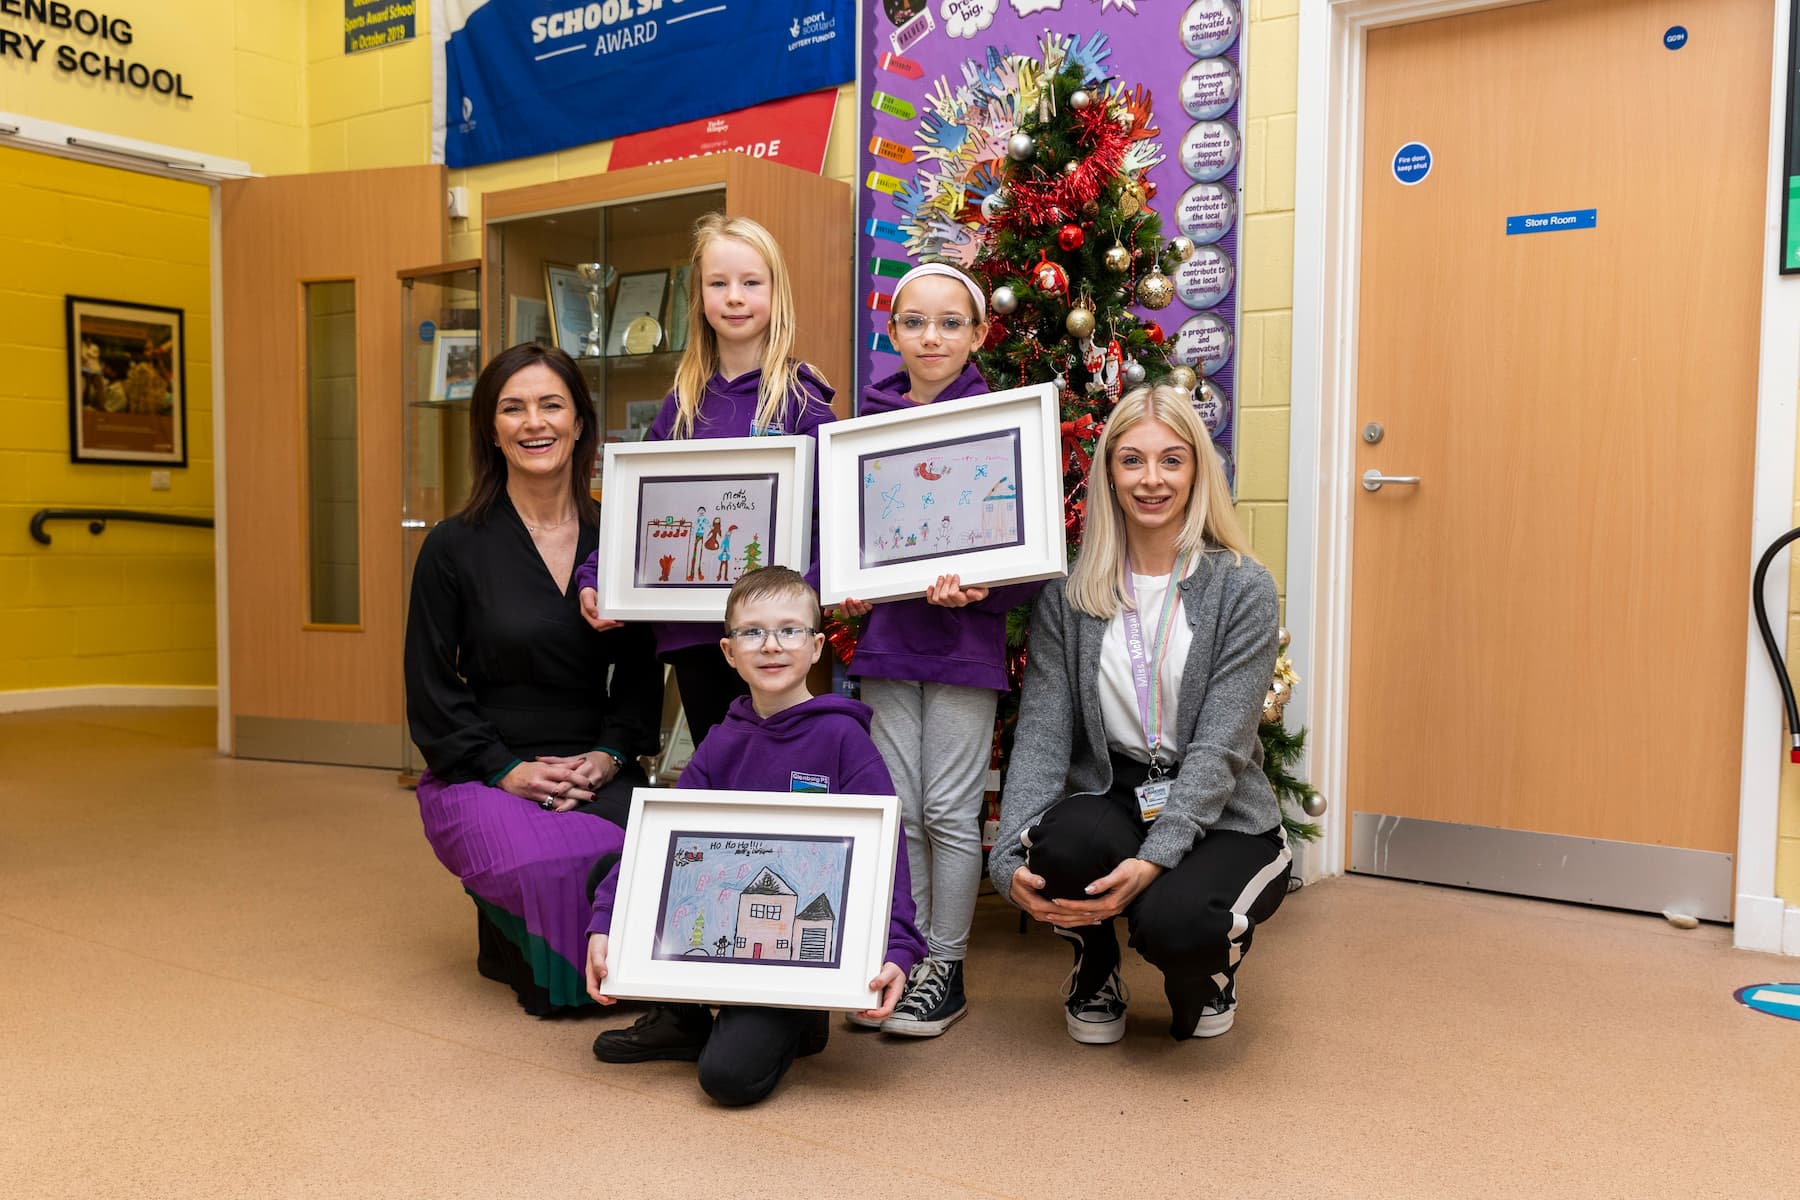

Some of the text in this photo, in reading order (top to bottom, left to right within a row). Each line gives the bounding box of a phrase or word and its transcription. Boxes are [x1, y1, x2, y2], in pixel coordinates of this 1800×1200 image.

[366, 10, 389, 26] Award
[389, 0, 416, 20] School
[948, 0, 974, 16] Dre
[0, 0, 133, 45] ENBOIG
[531, 0, 633, 43] SCHOOL
[803, 10, 825, 26] sport
[1189, 16, 1233, 32] motivated &
[802, 16, 836, 35] scotland
[351, 23, 406, 50] in October 2019
[594, 20, 658, 57] AWARD
[898, 20, 926, 46] VALUES
[1192, 28, 1230, 42] challenged
[788, 31, 837, 52] LOTTERY FUNDED
[57, 45, 193, 101] SCHOOL
[1192, 70, 1231, 84] improvement
[1199, 81, 1223, 92] through
[1194, 90, 1219, 101] support
[1189, 97, 1229, 109] collaboration
[1203, 131, 1220, 140] build
[1192, 139, 1231, 151] resilience to
[1198, 150, 1223, 161] support
[1398, 154, 1426, 164] Fire door
[1194, 158, 1225, 169] challenge
[1397, 162, 1428, 172] keep shut
[1192, 193, 1223, 203] value and
[1185, 202, 1229, 214] contribute to
[1192, 210, 1220, 222] the local
[1524, 215, 1577, 228] Store Room
[1187, 221, 1223, 232] community
[1189, 257, 1220, 268] value and
[1183, 265, 1226, 278] contribute to
[1190, 275, 1218, 286] the local
[1188, 325, 1225, 339] progressive
[1198, 334, 1210, 343] and
[1186, 344, 1220, 354] innovative
